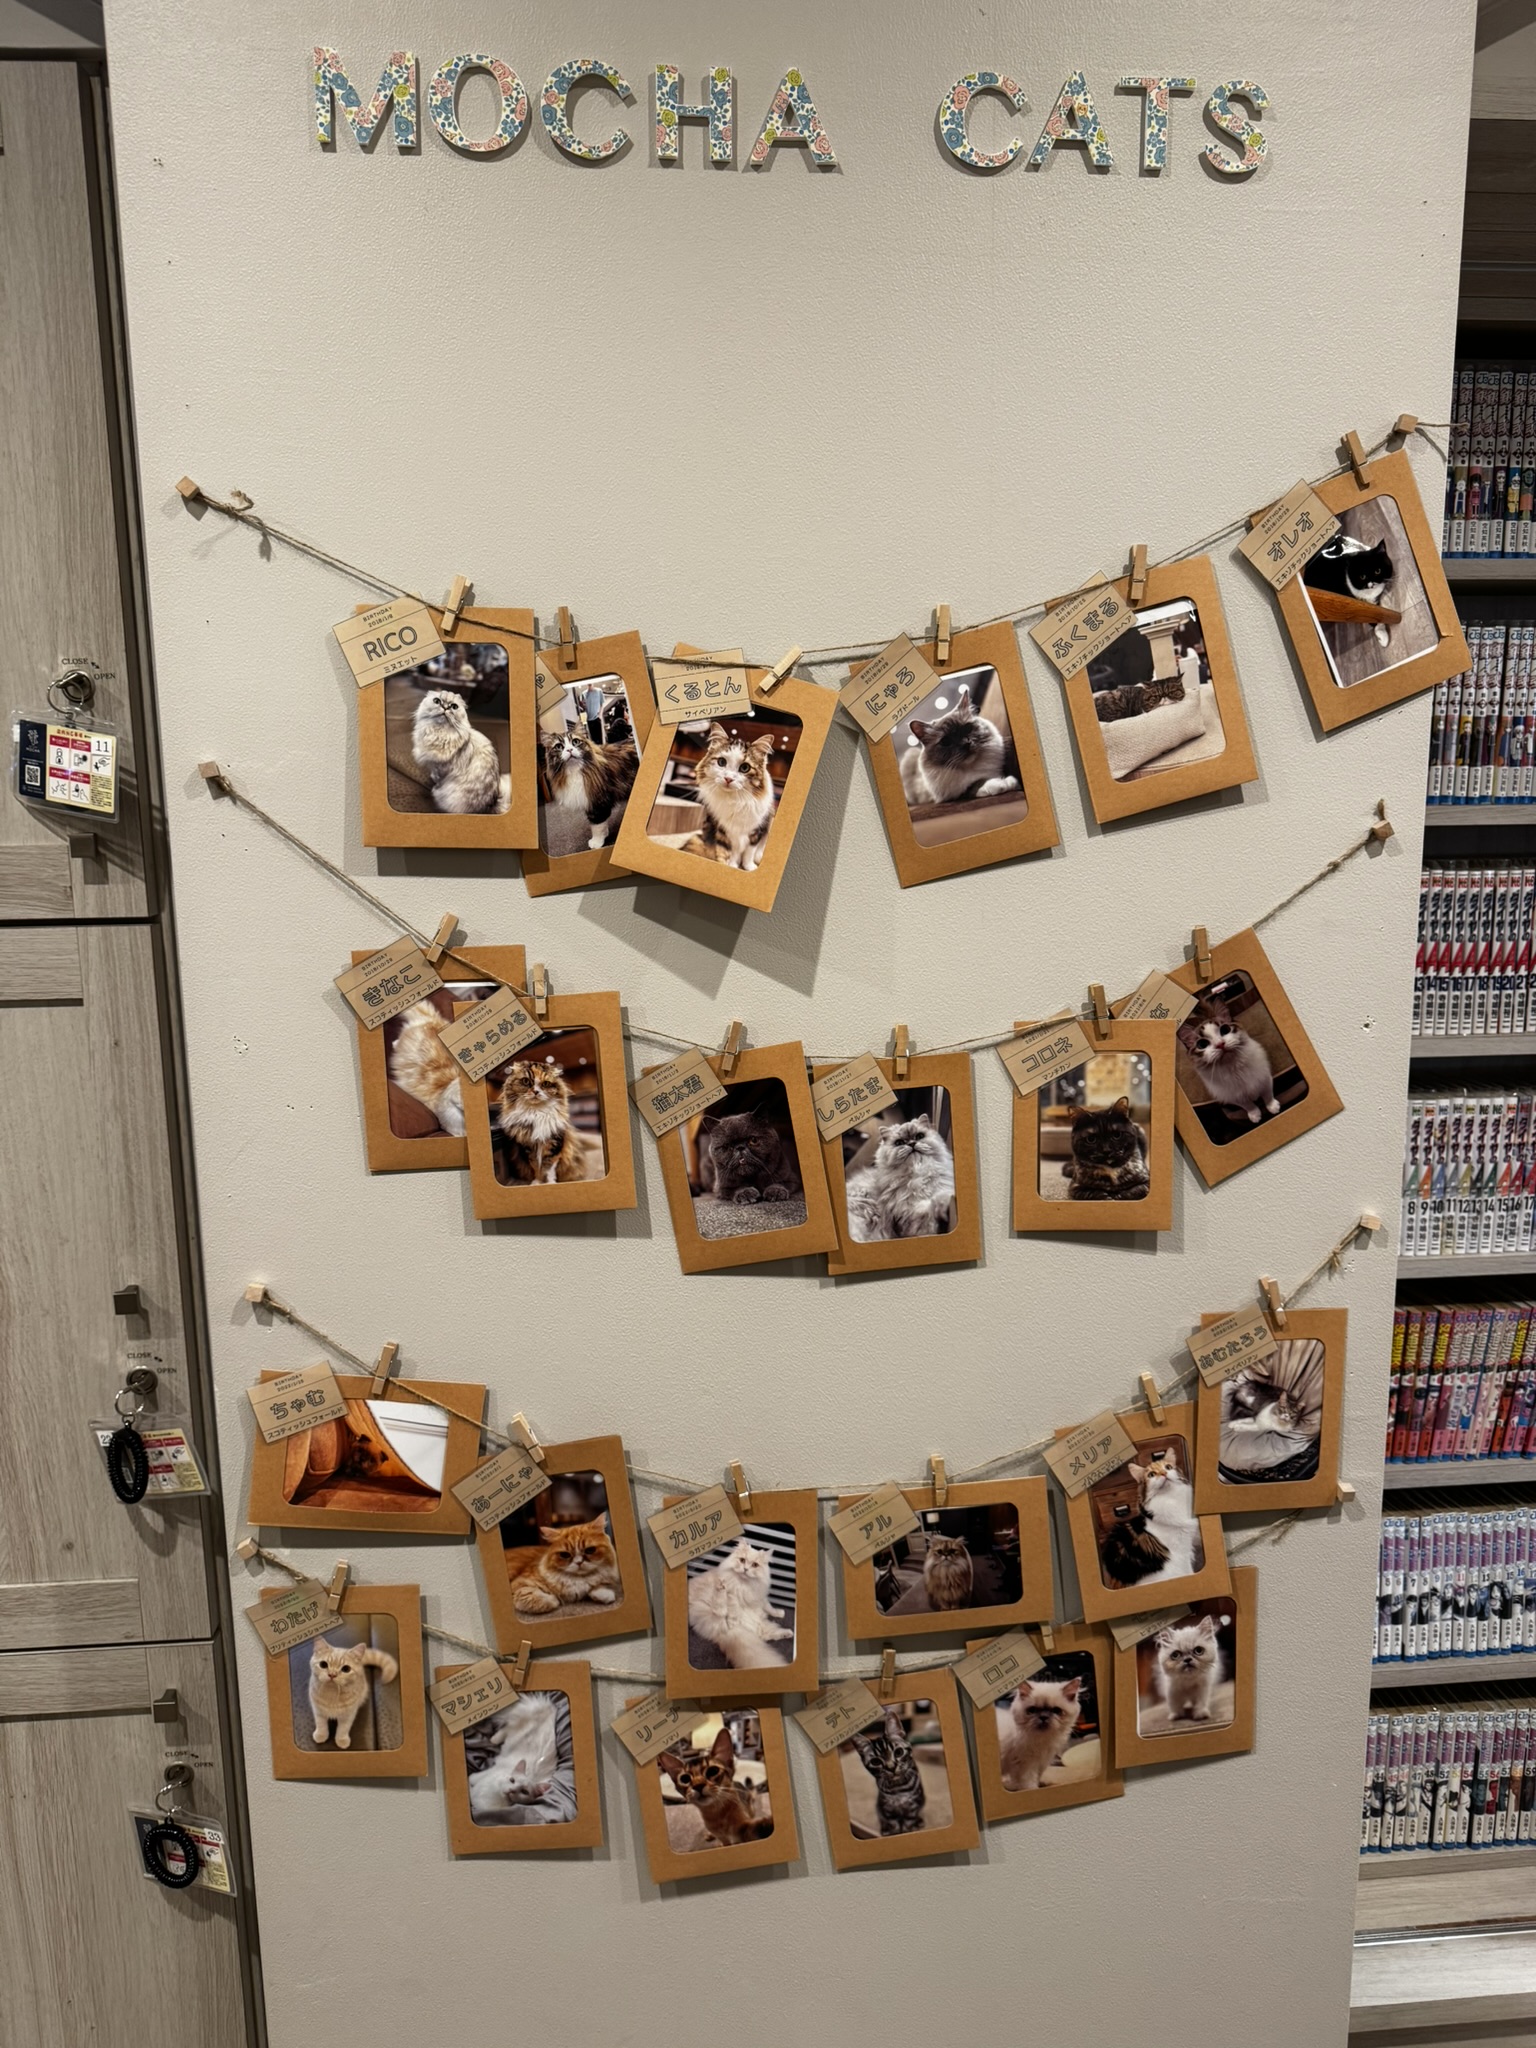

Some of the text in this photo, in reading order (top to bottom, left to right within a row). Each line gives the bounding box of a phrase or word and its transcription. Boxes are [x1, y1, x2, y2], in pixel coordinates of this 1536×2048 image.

[313, 47, 1273, 177] MOCHA CATS
[1261, 504, 1285, 529] BIRTHDAY
[1267, 511, 1315, 561] オレオ
[363, 606, 393, 622] BIRTHDAY
[1052, 597, 1119, 659] ふくまる
[362, 626, 418, 661] RICO
[61, 657, 89, 666] CLOSE
[384, 655, 417, 673] ミヌエット
[860, 657, 885, 679] BIRTHDAY
[94, 672, 116, 681] OPEN
[664, 676, 742, 703] くるとん
[865, 666, 916, 716] にゃろ
[685, 706, 727, 718] サイベリアン
[891, 695, 920, 721] ラグドール
[95, 740, 110, 753] 11
[361, 953, 388, 971] BIRTHDAY
[362, 964, 422, 1007] きなこ
[368, 979, 440, 1026] スコティッシュフォールド
[463, 1004, 488, 1024] BIRTHDAY
[1123, 994, 1143, 1018] BIRTHDAY
[457, 1009, 528, 1064] きゃらめる
[472, 1028, 538, 1078] スコティッシュフォールド
[1022, 1036, 1073, 1073] コロネ
[651, 1063, 677, 1080] BIRTHDAY
[823, 1068, 849, 1084] BIRTHDAY
[1041, 1062, 1071, 1081] マンチカン
[651, 1074, 705, 1114] 猫太君
[817, 1076, 884, 1123] しらたま
[656, 1088, 723, 1132] エキゾチックショートヘア
[848, 1108, 872, 1124] ペルシャ
[1408, 1202, 1416, 1215] 8
[1420, 1201, 1429, 1215] 9
[1432, 1201, 1443, 1214] 10
[1446, 1199, 1456, 1213] 11
[1458, 1200, 1470, 1213] 12
[1471, 1199, 1482, 1214] 13
[1484, 1199, 1494, 1213] 14
[1497, 1199, 1508, 1212] 15
[1510, 1197, 1521, 1211] 16
[1524, 1196, 1534, 1210] 17
[1225, 1354, 1258, 1375] サイベリアン
[270, 1389, 326, 1420] ちゃむ
[267, 1406, 344, 1439] スコティッシュフォールド
[1069, 1435, 1112, 1476] メリア
[471, 1466, 533, 1513] あーにゃ
[669, 1510, 722, 1549] カルア
[859, 1514, 892, 1540] アル
[688, 1536, 724, 1556] ラガマフィン
[270, 1601, 319, 1635] わたげ
[982, 1654, 1020, 1685] ロコ
[441, 1676, 503, 1716] マシェリ
[636, 1706, 681, 1742] リーナ
[825, 1706, 856, 1728] テト
[208, 1831, 222, 1842] 33
